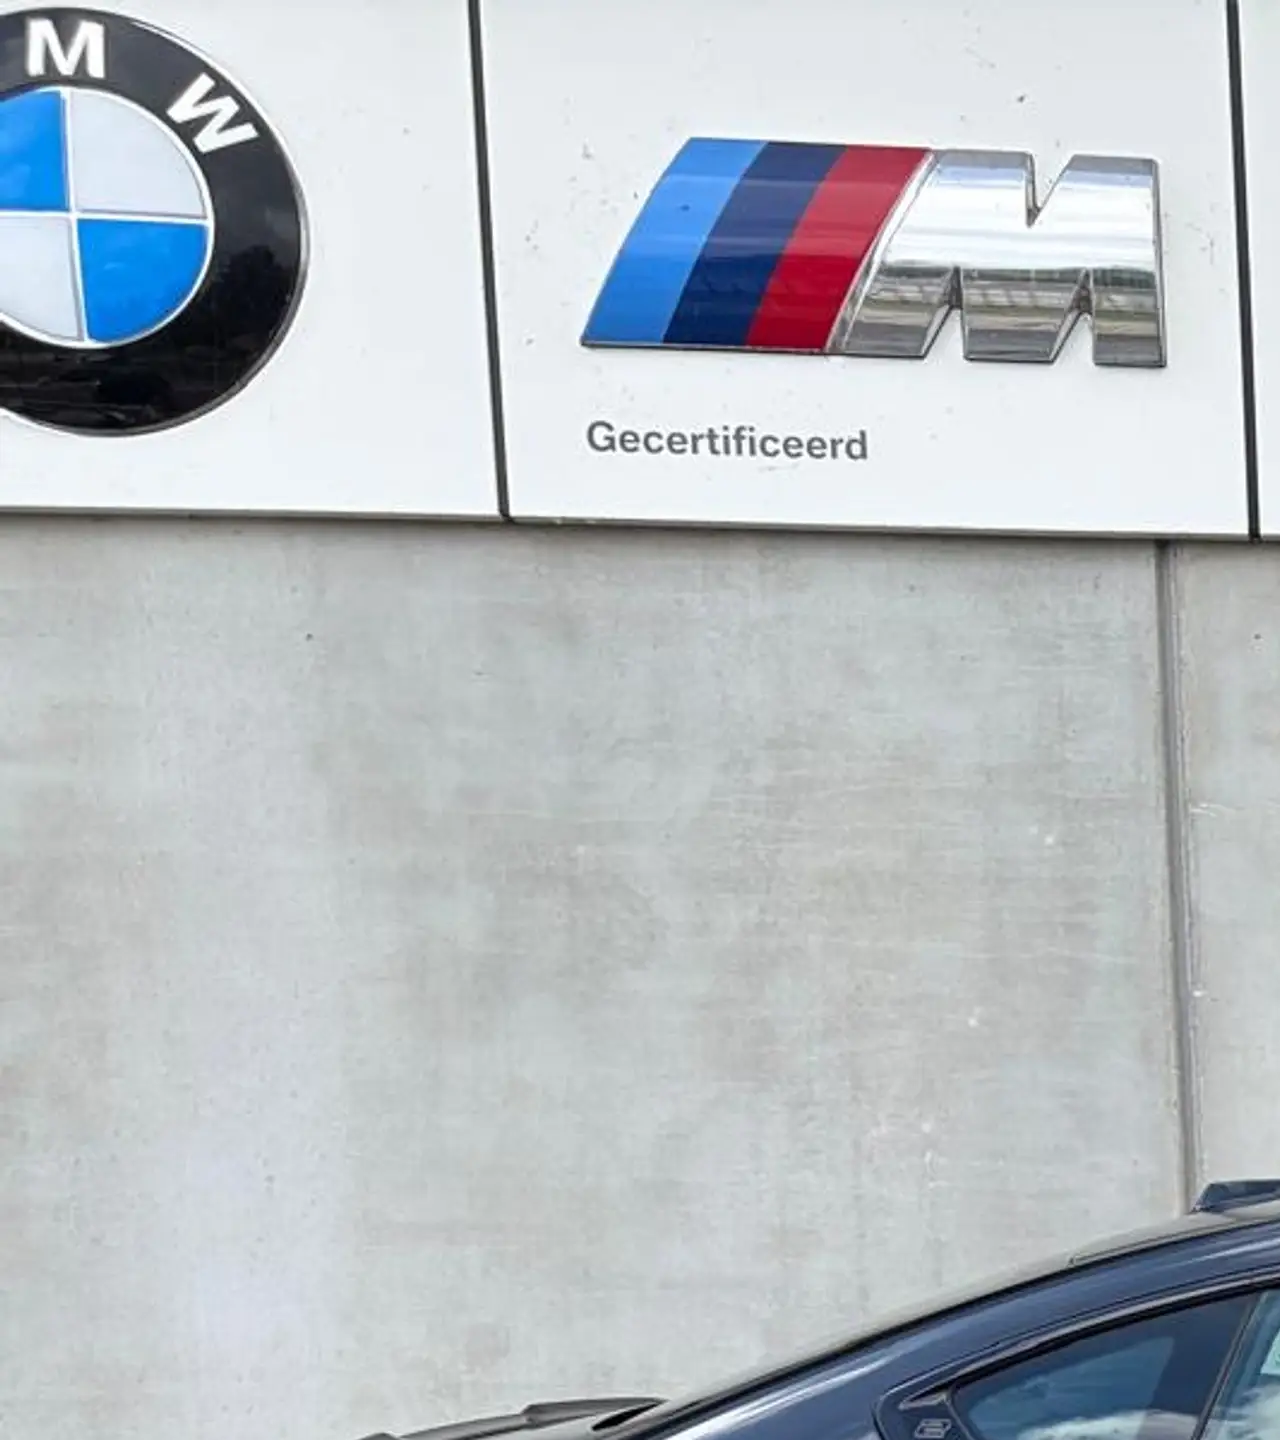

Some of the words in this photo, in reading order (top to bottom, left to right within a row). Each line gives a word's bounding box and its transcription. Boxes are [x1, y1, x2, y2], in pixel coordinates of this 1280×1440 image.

[25, 17, 260, 154] MW
[827, 148, 1167, 368] M
[586, 420, 869, 461] Gecertificeerd
